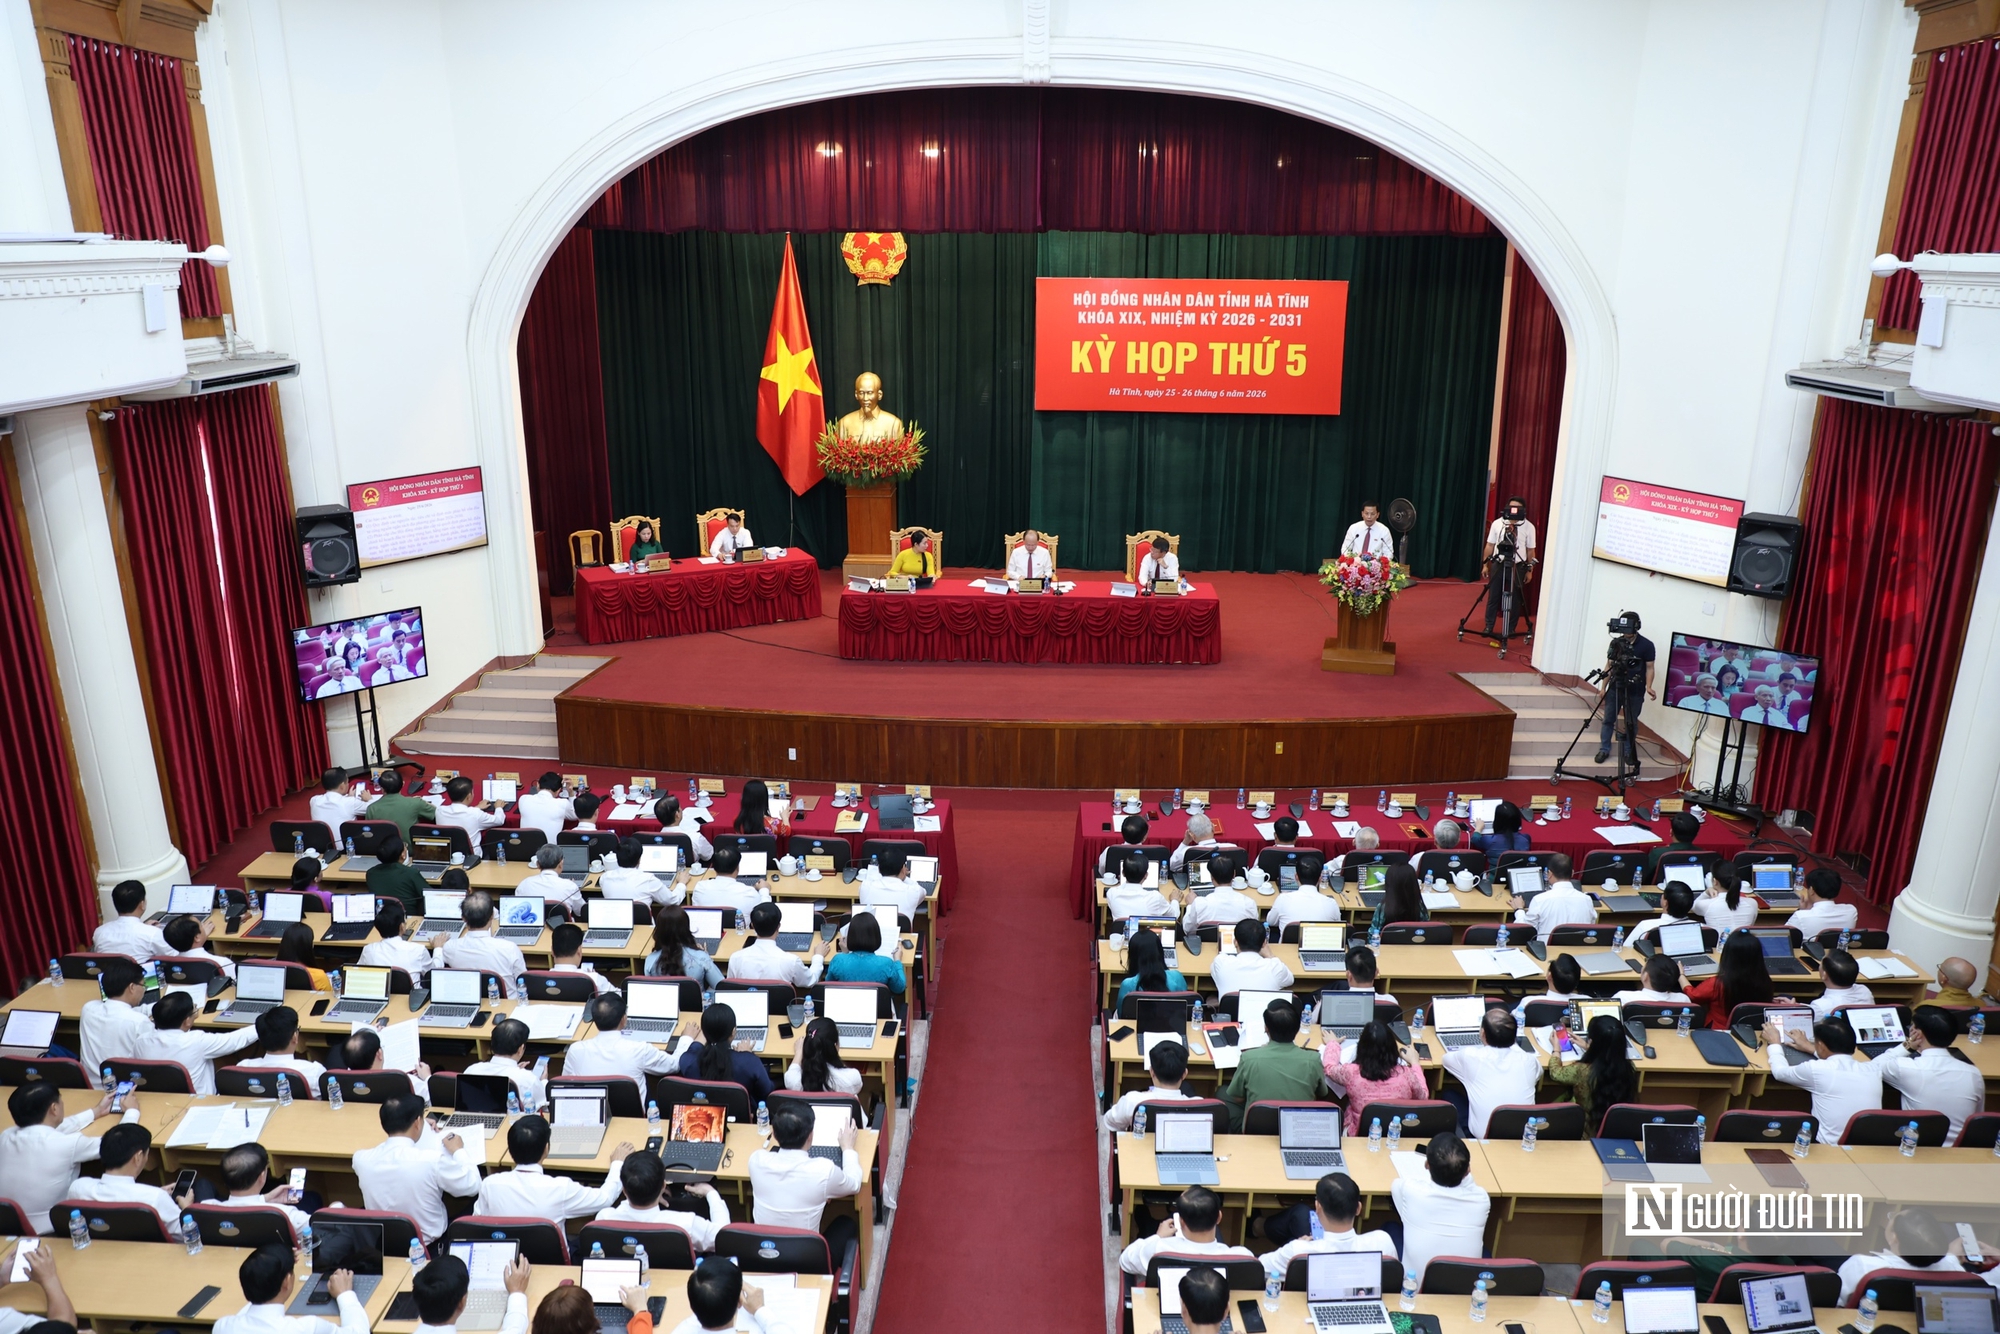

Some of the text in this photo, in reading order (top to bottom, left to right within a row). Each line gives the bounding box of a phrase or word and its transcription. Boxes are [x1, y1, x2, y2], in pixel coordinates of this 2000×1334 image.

[1073, 289, 1309, 309] HỘI ĐỒNG NHÂN DÂN TỈNH HÀ TĨNH
[1078, 309, 1115, 324] KHÓA
[1118, 311, 1146, 326] XIX,
[1150, 309, 1196, 328] NHIỆM
[1200, 310, 1218, 325] KỲ
[1222, 313, 1255, 326] 2026
[1269, 313, 1302, 327] 2031
[1071, 334, 1307, 382] KỲ HỌP THỨ 5
[1109, 388, 1120, 396] Hà
[1122, 388, 1143, 397] Tĩnh,
[1144, 388, 1164, 398] ngày
[1182, 389, 1193, 397] 26
[1194, 389, 1218, 399] tháng
[1226, 389, 1244, 398] năm
[1245, 390, 1267, 398] 2026
